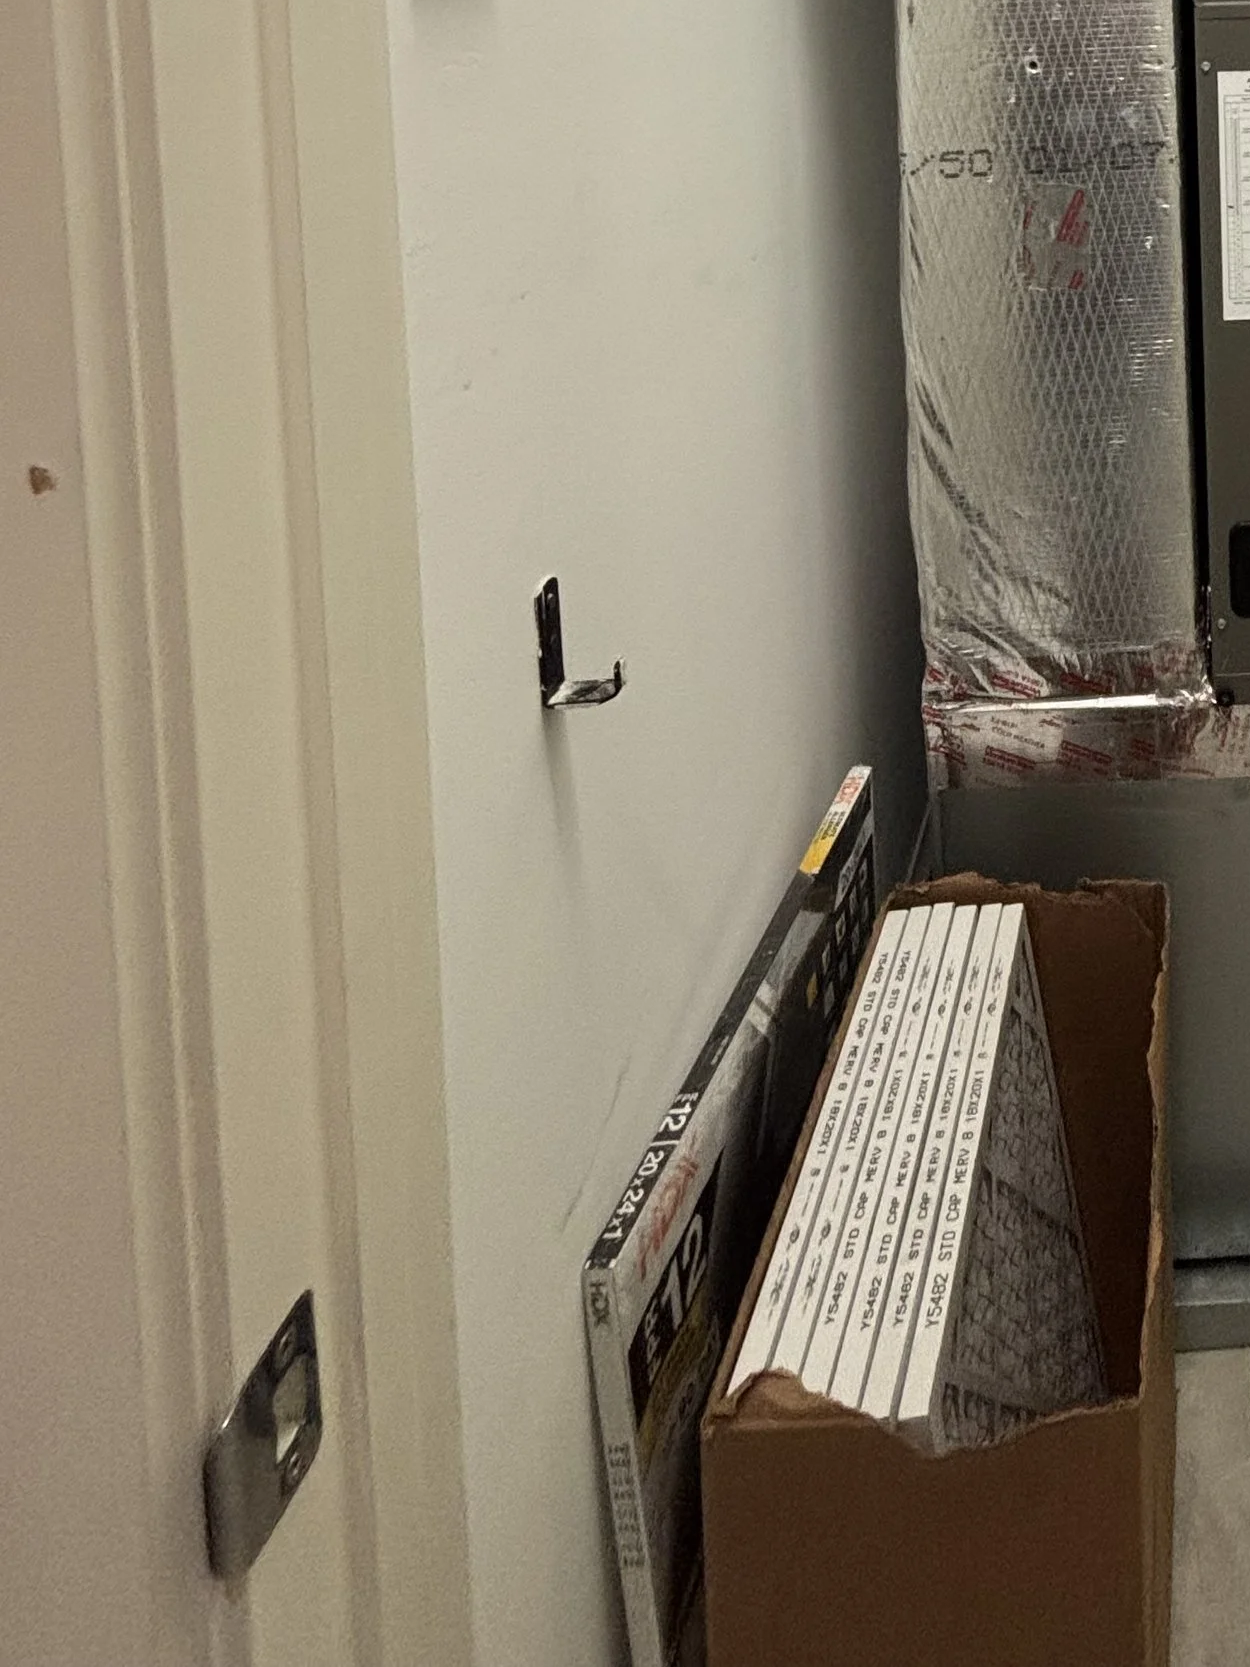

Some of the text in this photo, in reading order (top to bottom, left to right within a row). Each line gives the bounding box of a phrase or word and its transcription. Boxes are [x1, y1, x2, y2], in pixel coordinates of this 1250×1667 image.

[864, 991, 876, 1012] STD
[888, 989, 899, 1009] STD
[855, 1018, 868, 1038] CAP
[881, 1014, 892, 1036] CAP
[844, 1046, 858, 1076] MERV
[869, 1043, 884, 1073] MERV
[965, 1070, 985, 1123] 18X20X1
[659, 1104, 692, 1133] 12
[817, 1100, 842, 1154] 18X20X1
[846, 1097, 868, 1150] 18X20X1
[844, 1228, 859, 1259] STD
[855, 1193, 868, 1219] CAP
[867, 1148, 881, 1182] MERV
[882, 1069, 904, 1121] 18X20X1
[877, 1234, 892, 1265] STD
[887, 1198, 901, 1224] CAP
[896, 1152, 911, 1187] MERV
[912, 1072, 931, 1124] 18X20X1
[909, 1229, 924, 1259] STD
[918, 1193, 931, 1220] CAP
[926, 1148, 941, 1182] MERV
[940, 1068, 958, 1120] 18X20X1
[954, 1147, 970, 1184] MERV
[946, 1193, 962, 1222] CAP
[939, 1231, 956, 1261] STD
